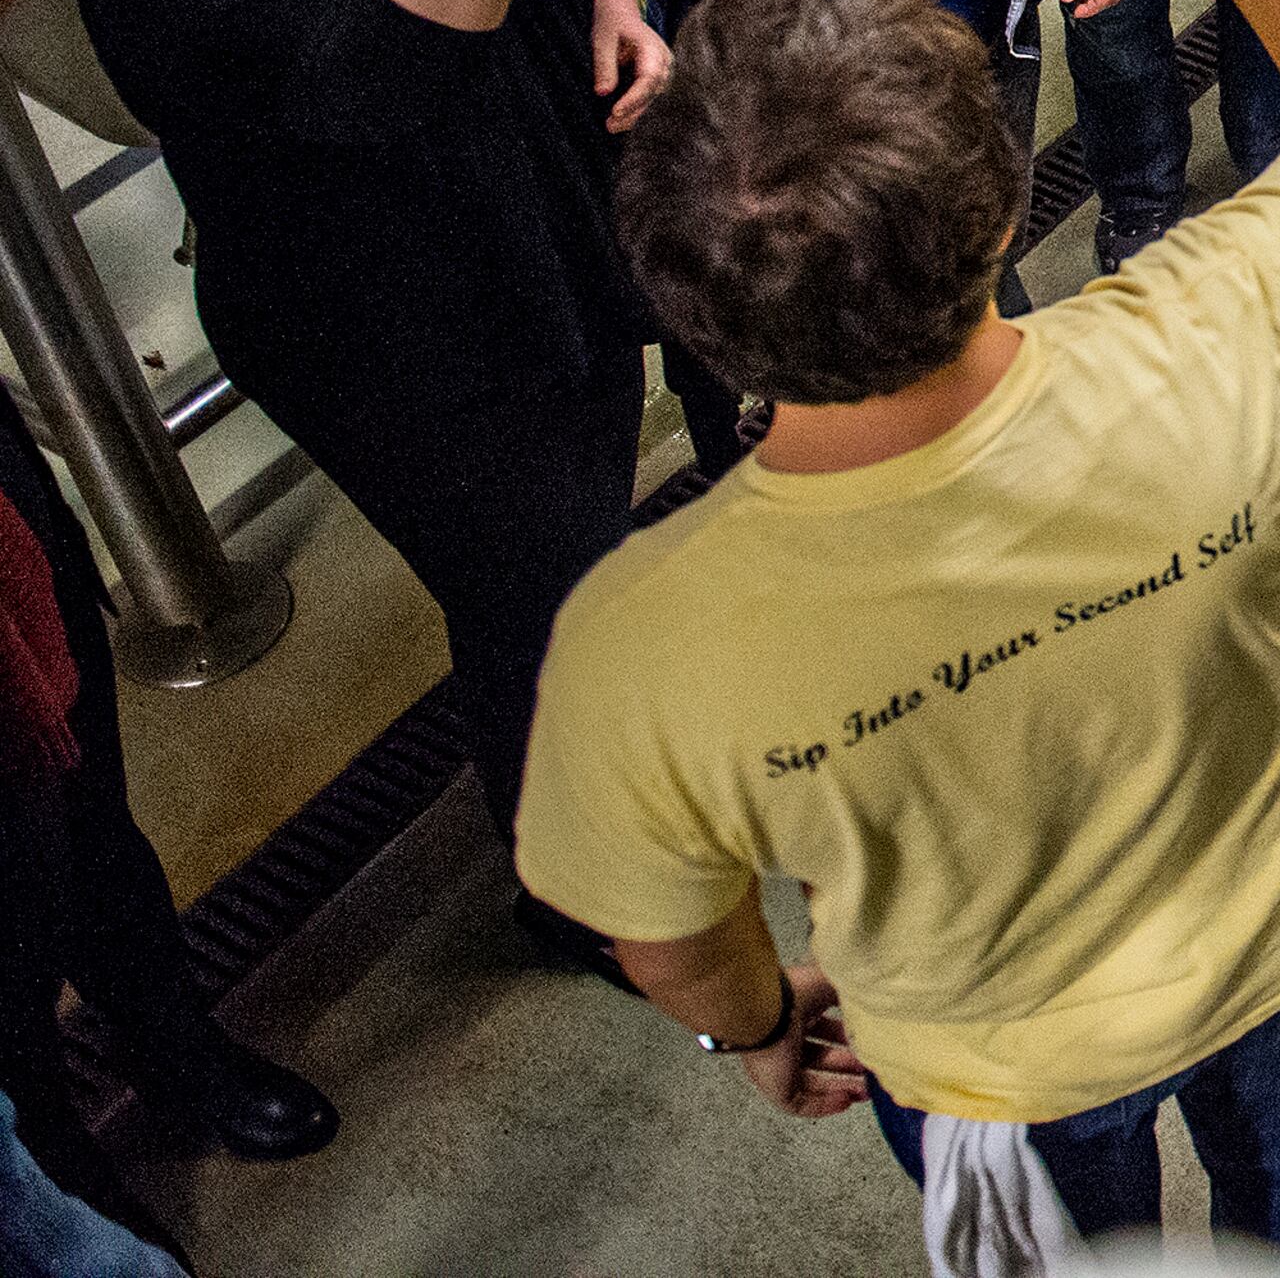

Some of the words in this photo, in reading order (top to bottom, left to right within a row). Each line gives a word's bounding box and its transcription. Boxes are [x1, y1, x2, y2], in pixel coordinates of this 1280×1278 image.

[764, 741, 829, 778] Sip
[843, 689, 925, 747] Into
[931, 629, 1041, 694] Your
[1054, 552, 1185, 633] Second
[1198, 502, 1258, 569] Self
